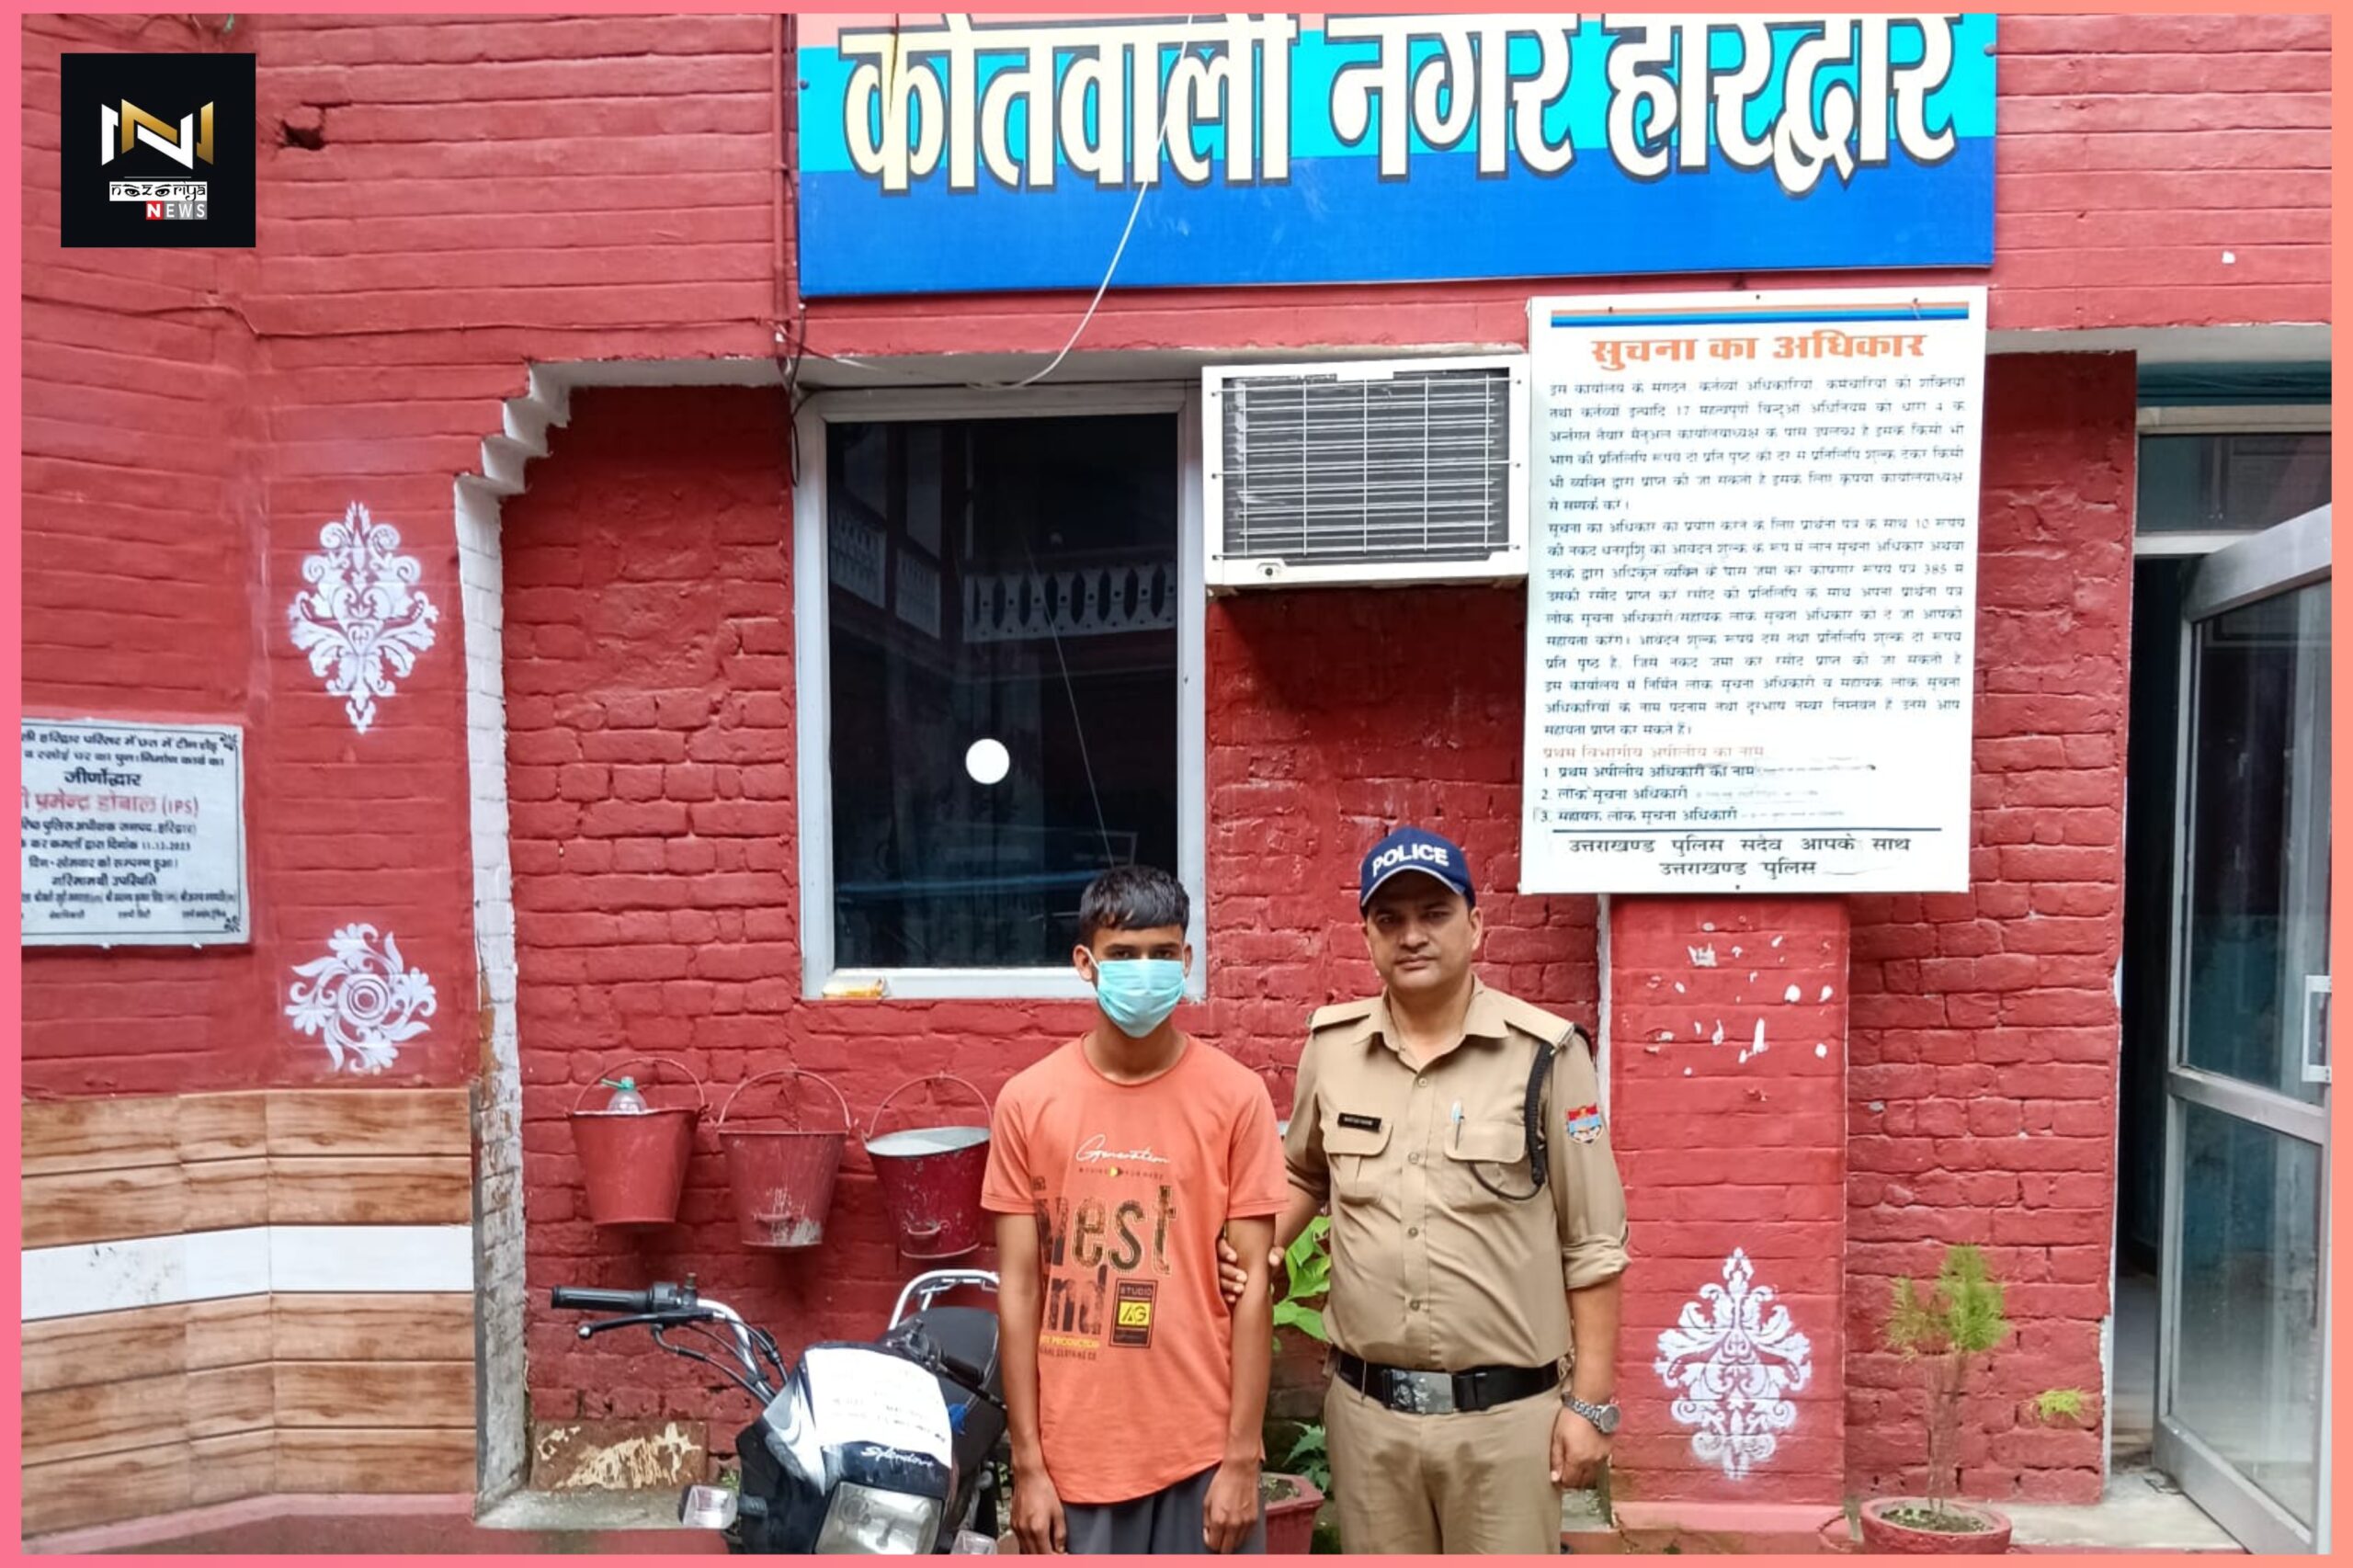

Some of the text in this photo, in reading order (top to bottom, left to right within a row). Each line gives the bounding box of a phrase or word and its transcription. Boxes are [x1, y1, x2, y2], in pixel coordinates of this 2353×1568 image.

[838, 13, 1302, 197] कोतवाली
[1324, 13, 1582, 182] नगर
[1708, 336, 1759, 360] का
[1772, 330, 1927, 360] अधिकार
[162, 796, 199, 818] (IPS)
[1568, 833, 1911, 855] उत्तराखण्ड पुलिस सदैव आपके साथ
[1372, 843, 1449, 878] POLICE
[1658, 857, 1817, 878] उत्तराखण्ड पुलिस
